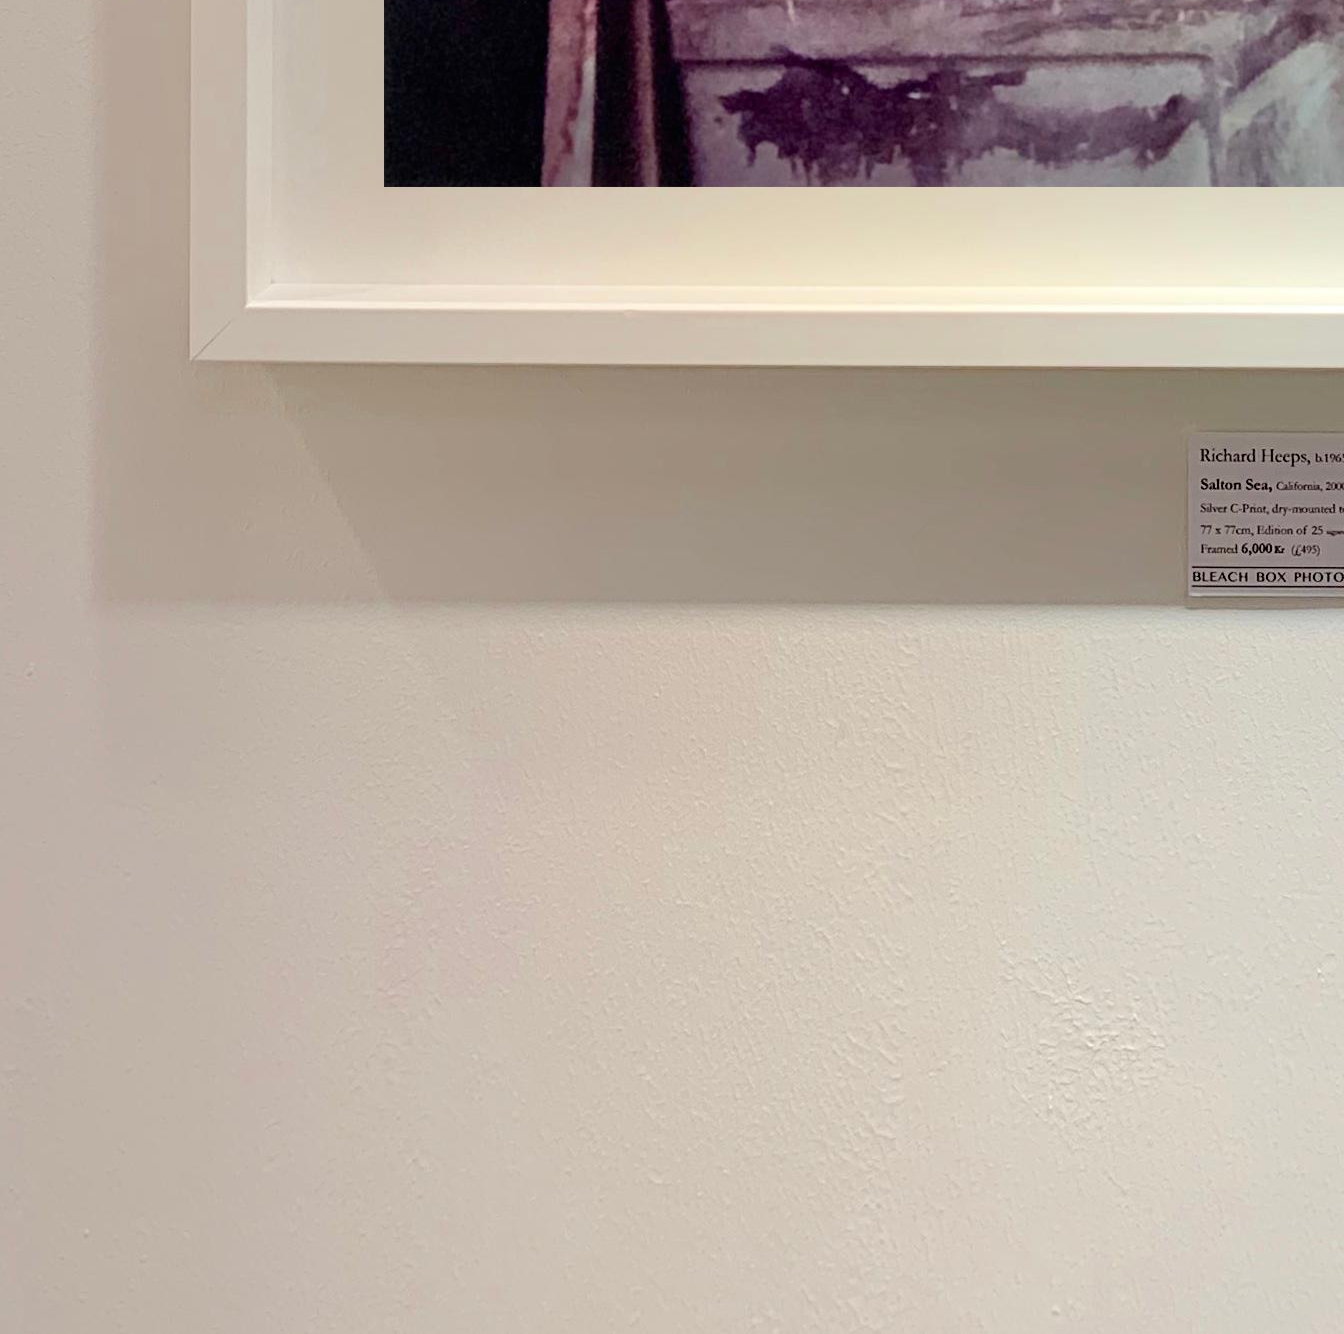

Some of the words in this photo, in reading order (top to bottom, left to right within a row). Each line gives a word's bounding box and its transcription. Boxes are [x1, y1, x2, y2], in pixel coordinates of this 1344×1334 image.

[1200, 448, 1256, 463] Richard
[1261, 448, 1311, 467] Heeps,
[1200, 478, 1242, 490] Salton
[1245, 478, 1273, 492] Sea,
[1276, 481, 1323, 491] California,
[1200, 503, 1227, 513] Silver
[1230, 503, 1270, 515] C-Print,
[1272, 503, 1336, 516] dry-mounted
[1200, 525, 1212, 535] 77
[1224, 525, 1254, 536] 77cm,
[1257, 524, 1294, 535] Edition
[1296, 525, 1308, 535] of
[1311, 525, 1323, 535] 25
[1200, 544, 1238, 554] Framed
[1241, 543, 1273, 556] 6,000
[1274, 545, 1286, 554] Kr
[1192, 571, 1249, 583] BLEACH
[1256, 572, 1287, 583] BOX
